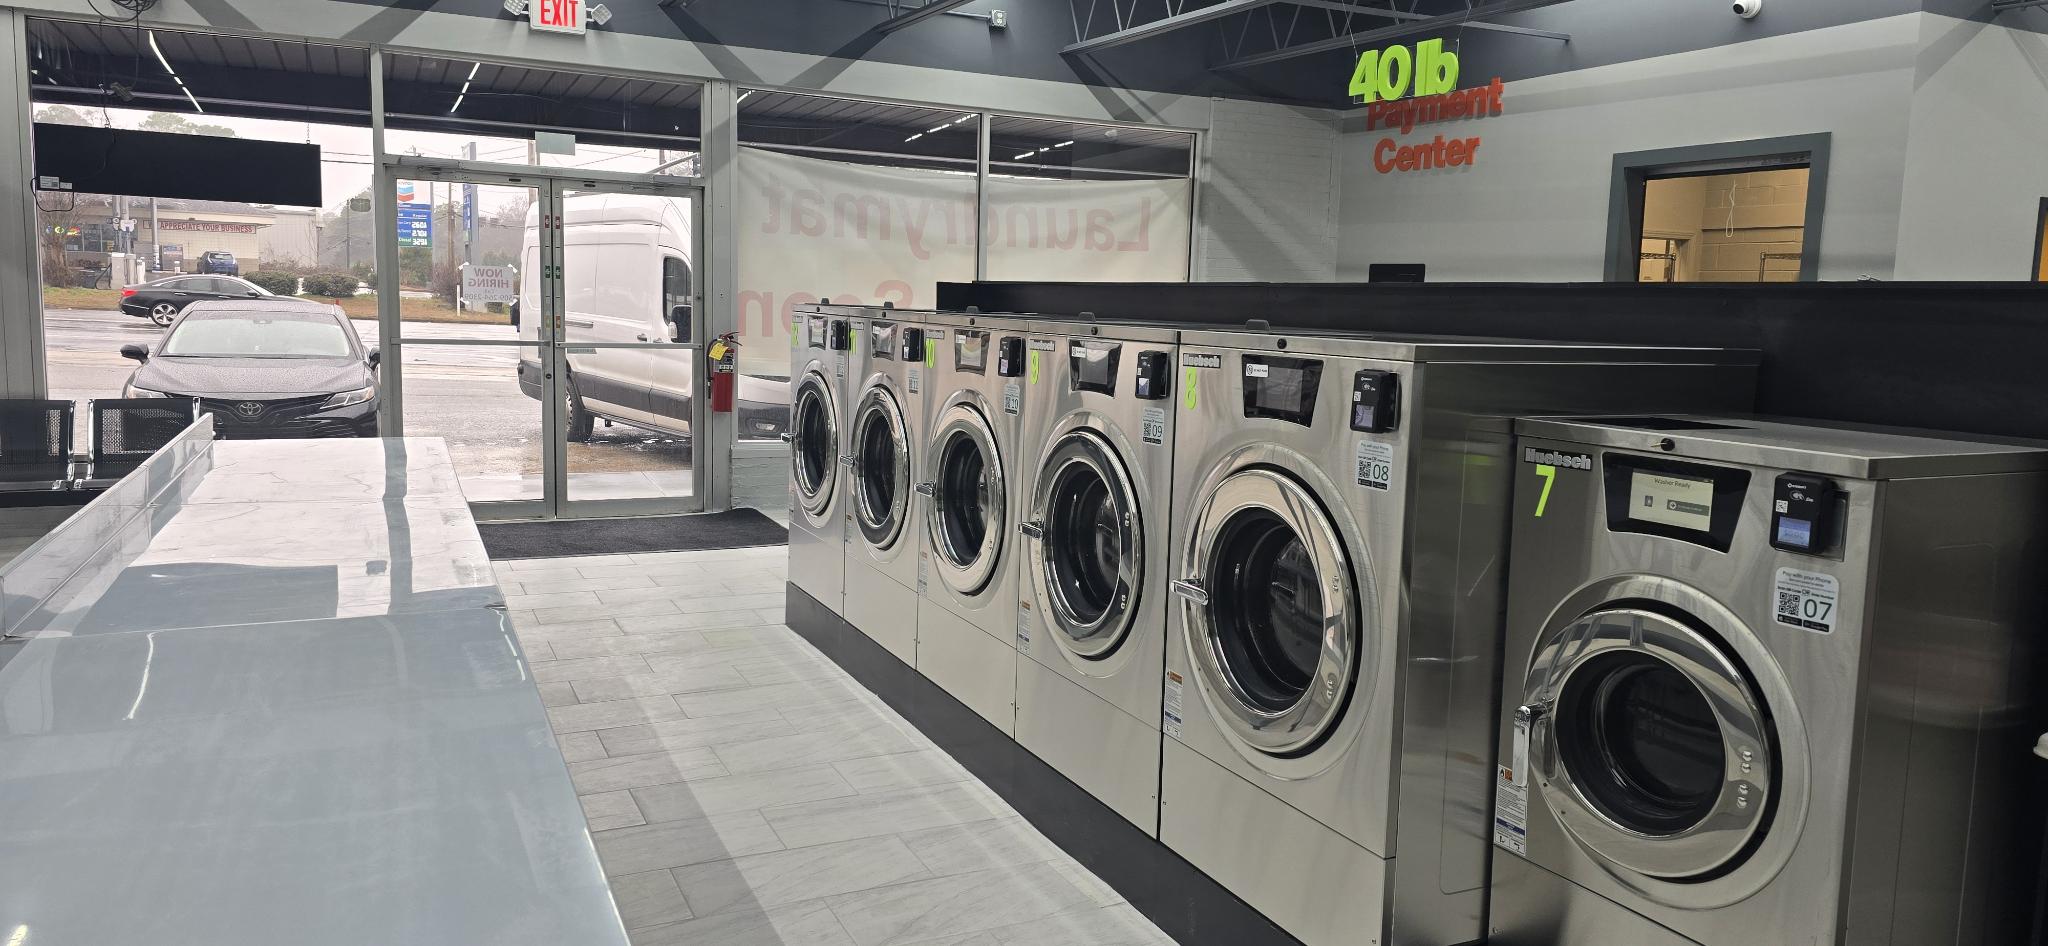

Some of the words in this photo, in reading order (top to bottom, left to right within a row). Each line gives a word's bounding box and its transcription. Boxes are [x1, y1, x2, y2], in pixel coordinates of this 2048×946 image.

[540, 0, 579, 27] EXIT
[1349, 45, 1412, 103] 40
[1415, 38, 1460, 97] lb
[1367, 77, 1504, 134] Payment
[1374, 135, 1481, 173] Center
[160, 221, 200, 230] APPRECIATE
[202, 223, 220, 231] YOUR
[222, 224, 253, 233] BUSINESS
[1030, 350, 1039, 385] 9
[1184, 366, 1197, 410] 8
[1152, 424, 1163, 438] 09
[1373, 464, 1389, 481] 08
[1525, 447, 1592, 470] Huebsch
[1535, 463, 1556, 517] 7
[1804, 598, 1833, 621] 07
